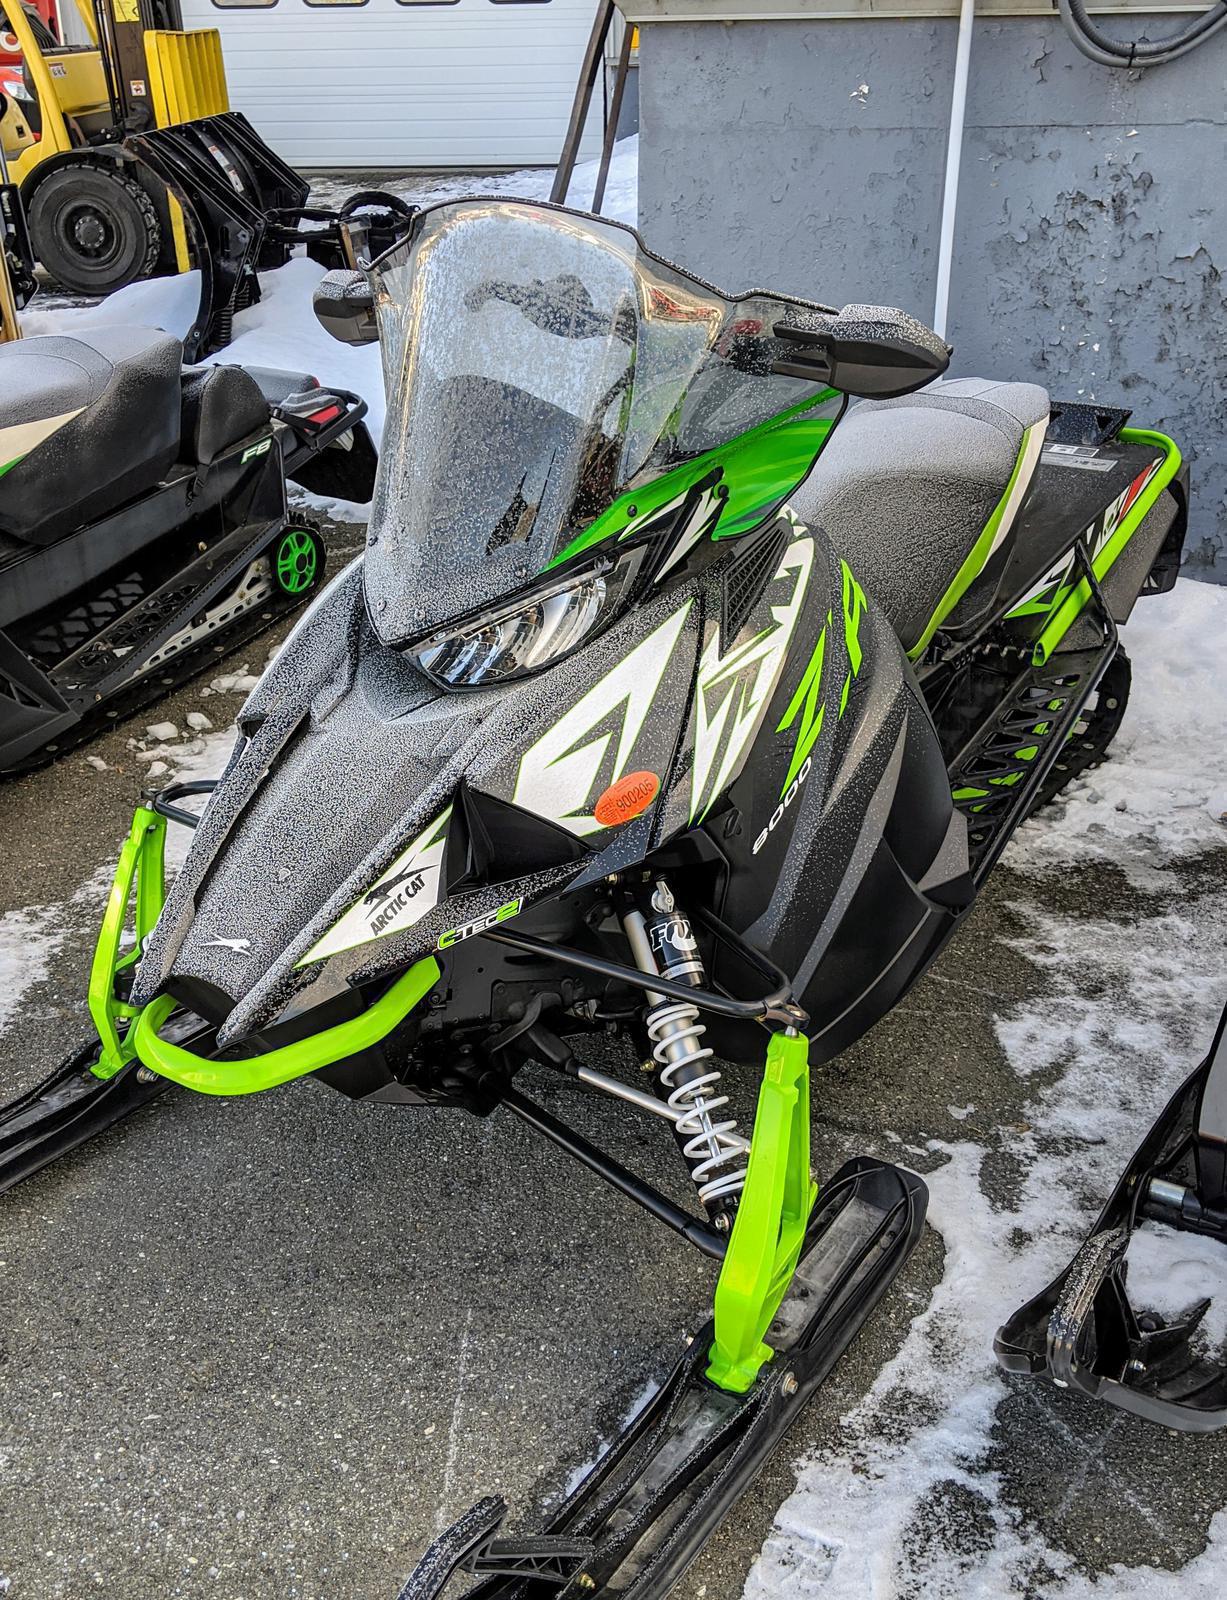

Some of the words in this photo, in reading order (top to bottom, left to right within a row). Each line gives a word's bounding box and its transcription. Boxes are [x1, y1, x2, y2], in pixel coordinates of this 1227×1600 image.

[241, 438, 272, 464] F8
[616, 779, 654, 812] 900205
[752, 756, 811, 855] 8000
[369, 893, 408, 936] ARCTIC
[404, 874, 426, 899] CAT
